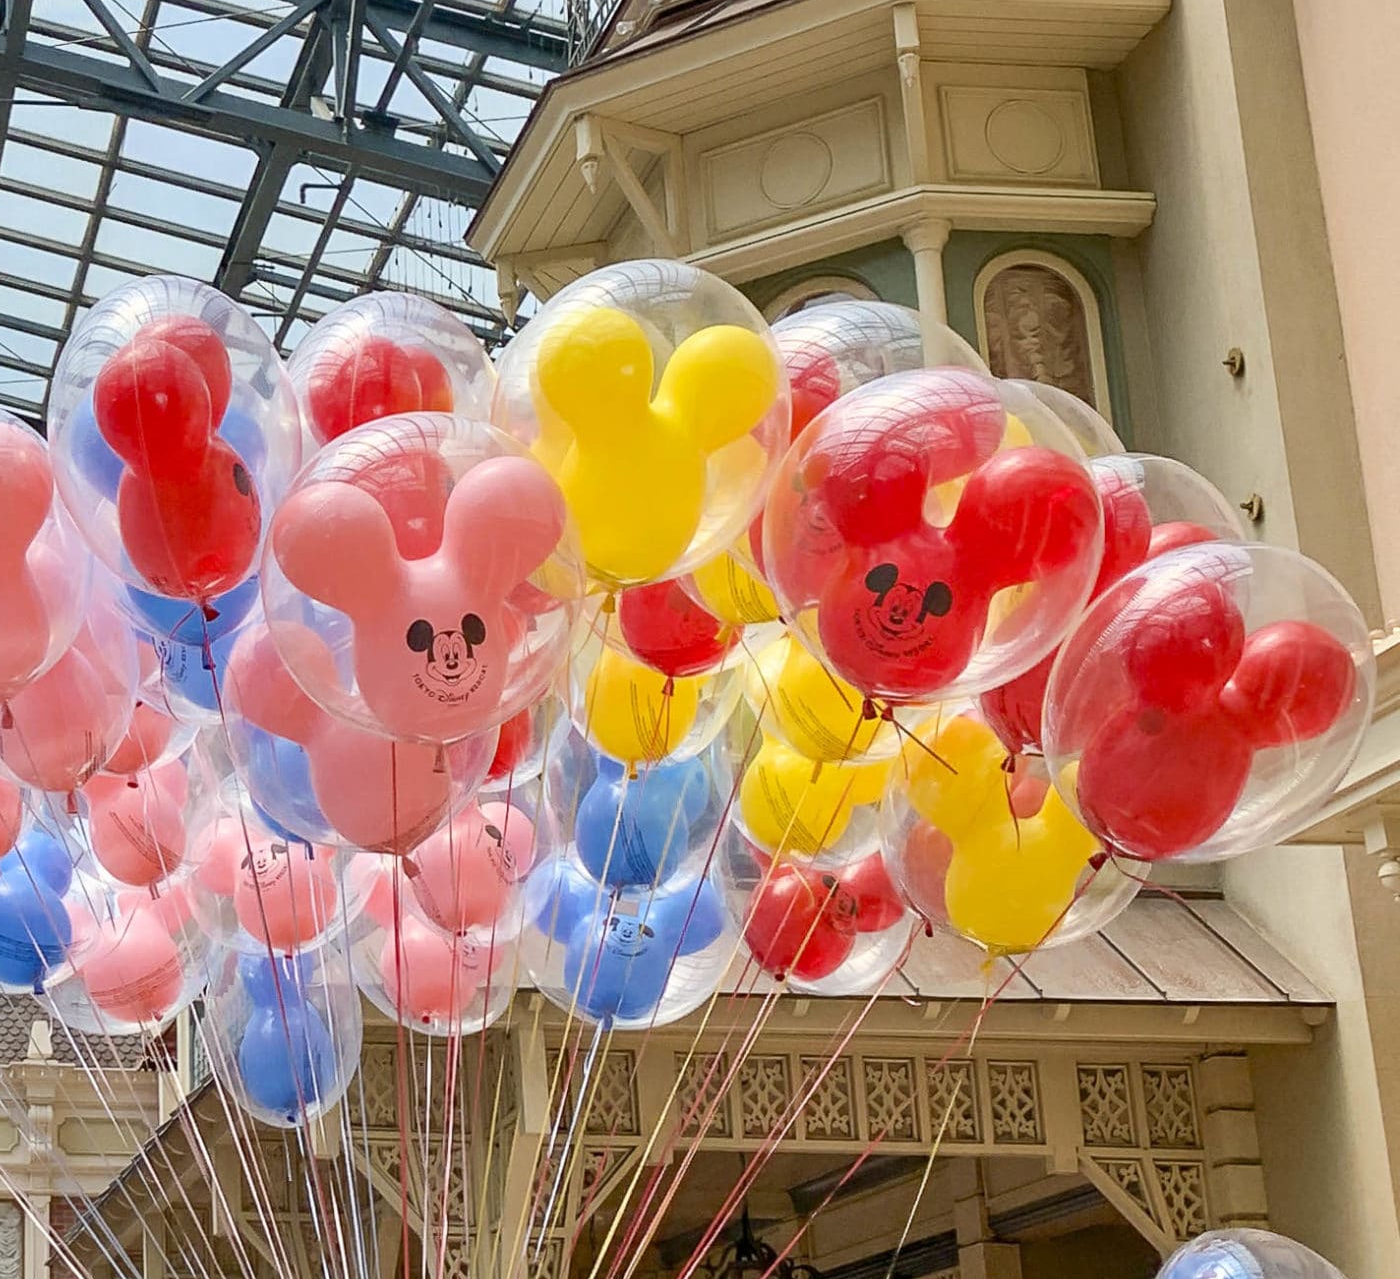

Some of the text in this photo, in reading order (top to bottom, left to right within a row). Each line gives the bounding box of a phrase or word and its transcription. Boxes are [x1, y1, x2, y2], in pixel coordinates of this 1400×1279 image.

[412, 664, 488, 702] TOKYO Disney RESORT
